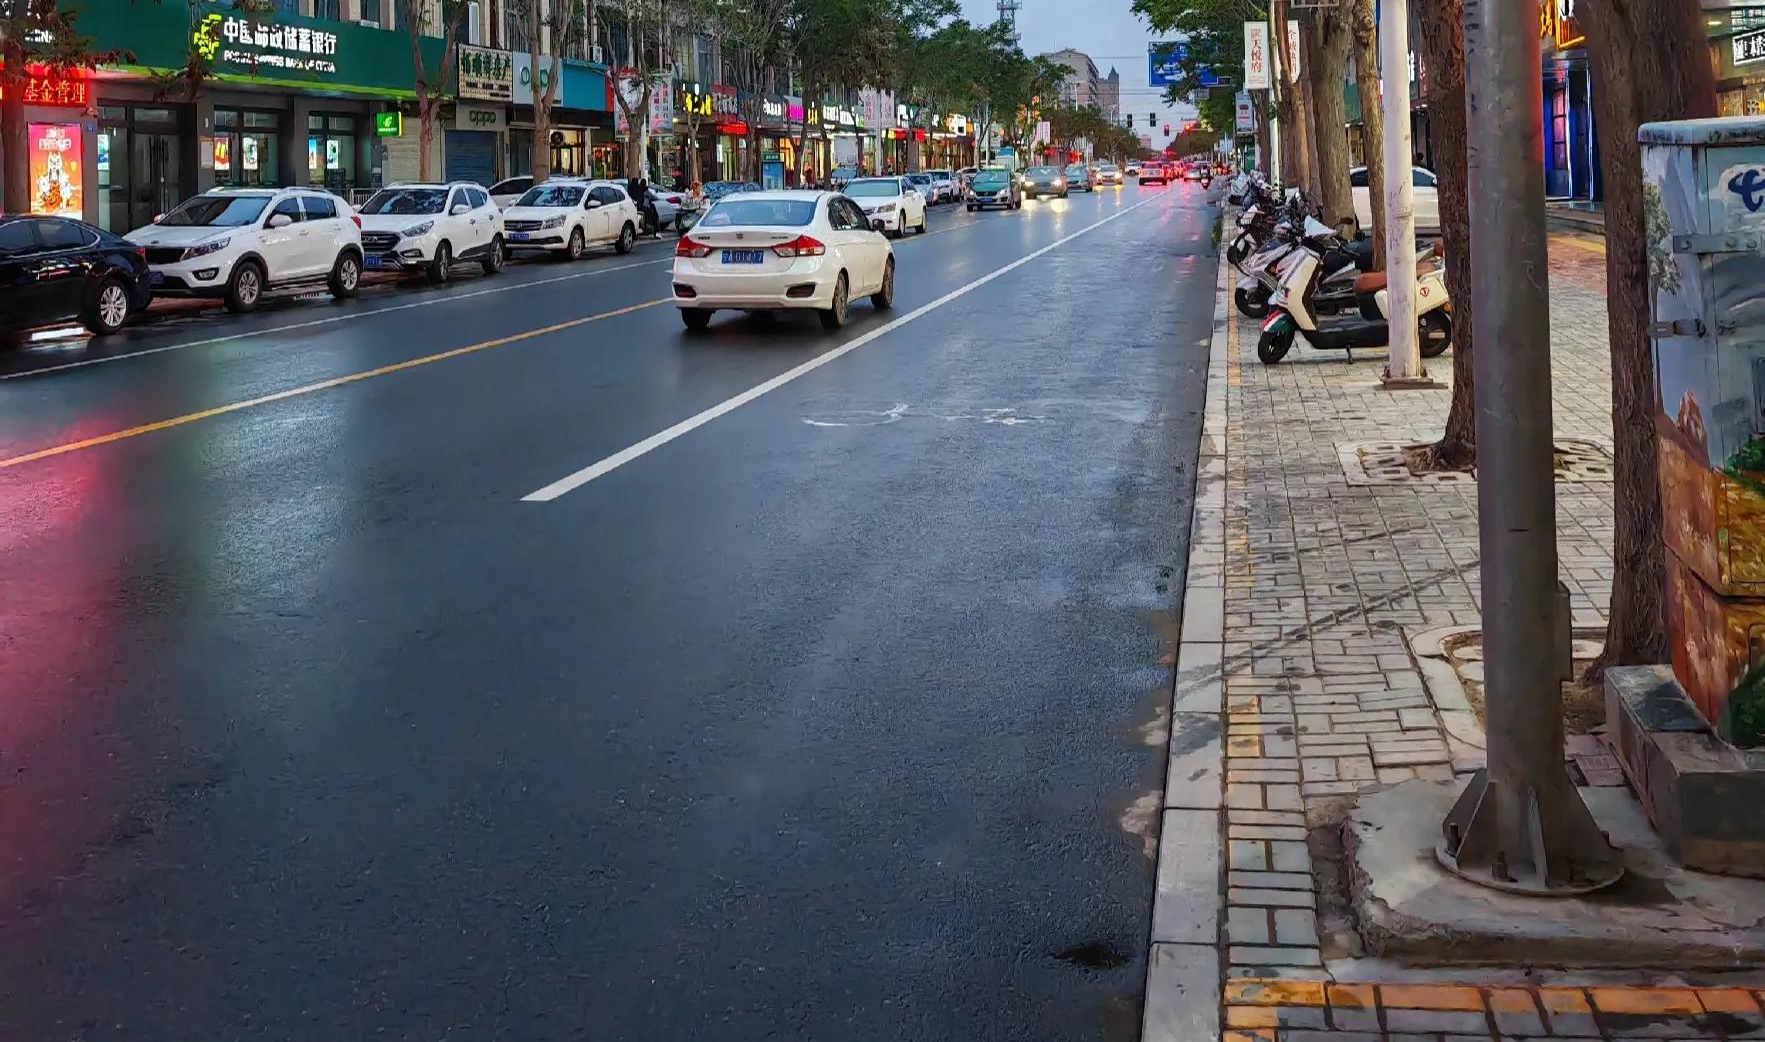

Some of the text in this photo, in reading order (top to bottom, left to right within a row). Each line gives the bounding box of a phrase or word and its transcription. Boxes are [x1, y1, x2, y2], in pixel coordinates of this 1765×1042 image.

[223, 16, 337, 54] 中国邮政储蓄银行
[23, 78, 86, 104] 基金管理
